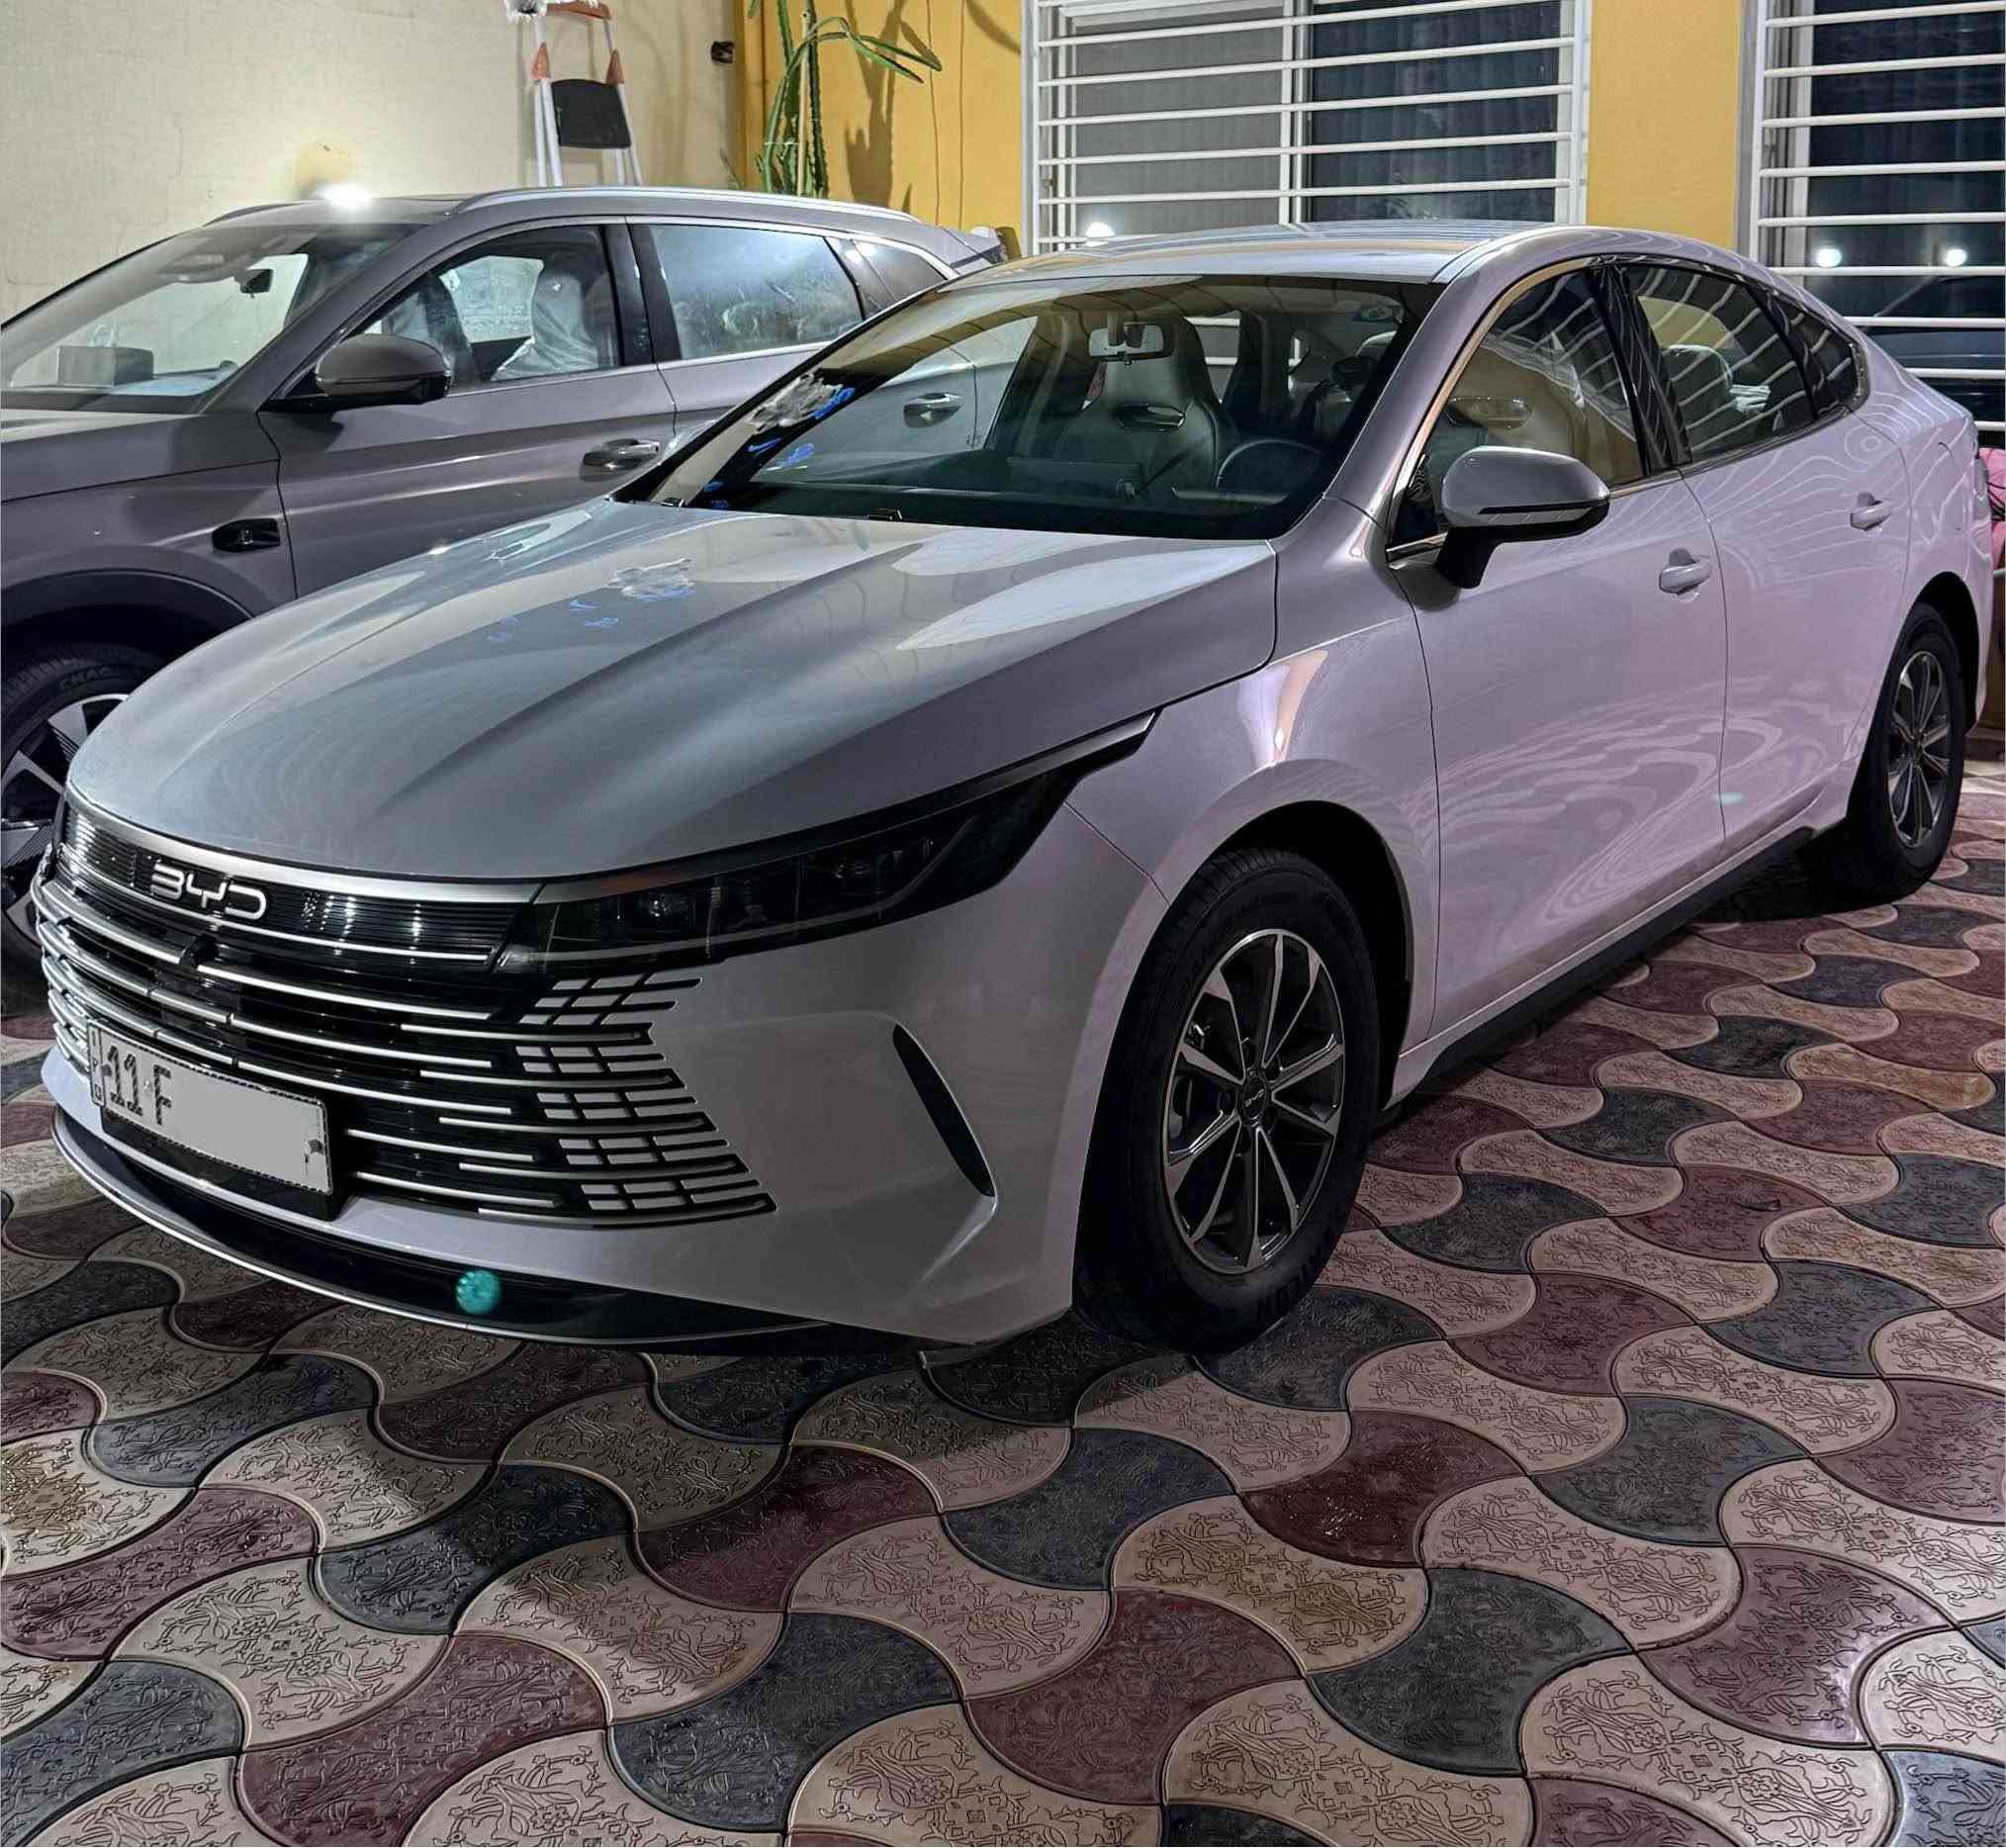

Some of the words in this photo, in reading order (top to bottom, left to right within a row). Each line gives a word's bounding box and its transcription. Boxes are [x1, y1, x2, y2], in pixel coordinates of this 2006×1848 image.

[151, 863, 266, 920] BYD
[108, 1045, 143, 1116] 11
[153, 1064, 171, 1125] F
